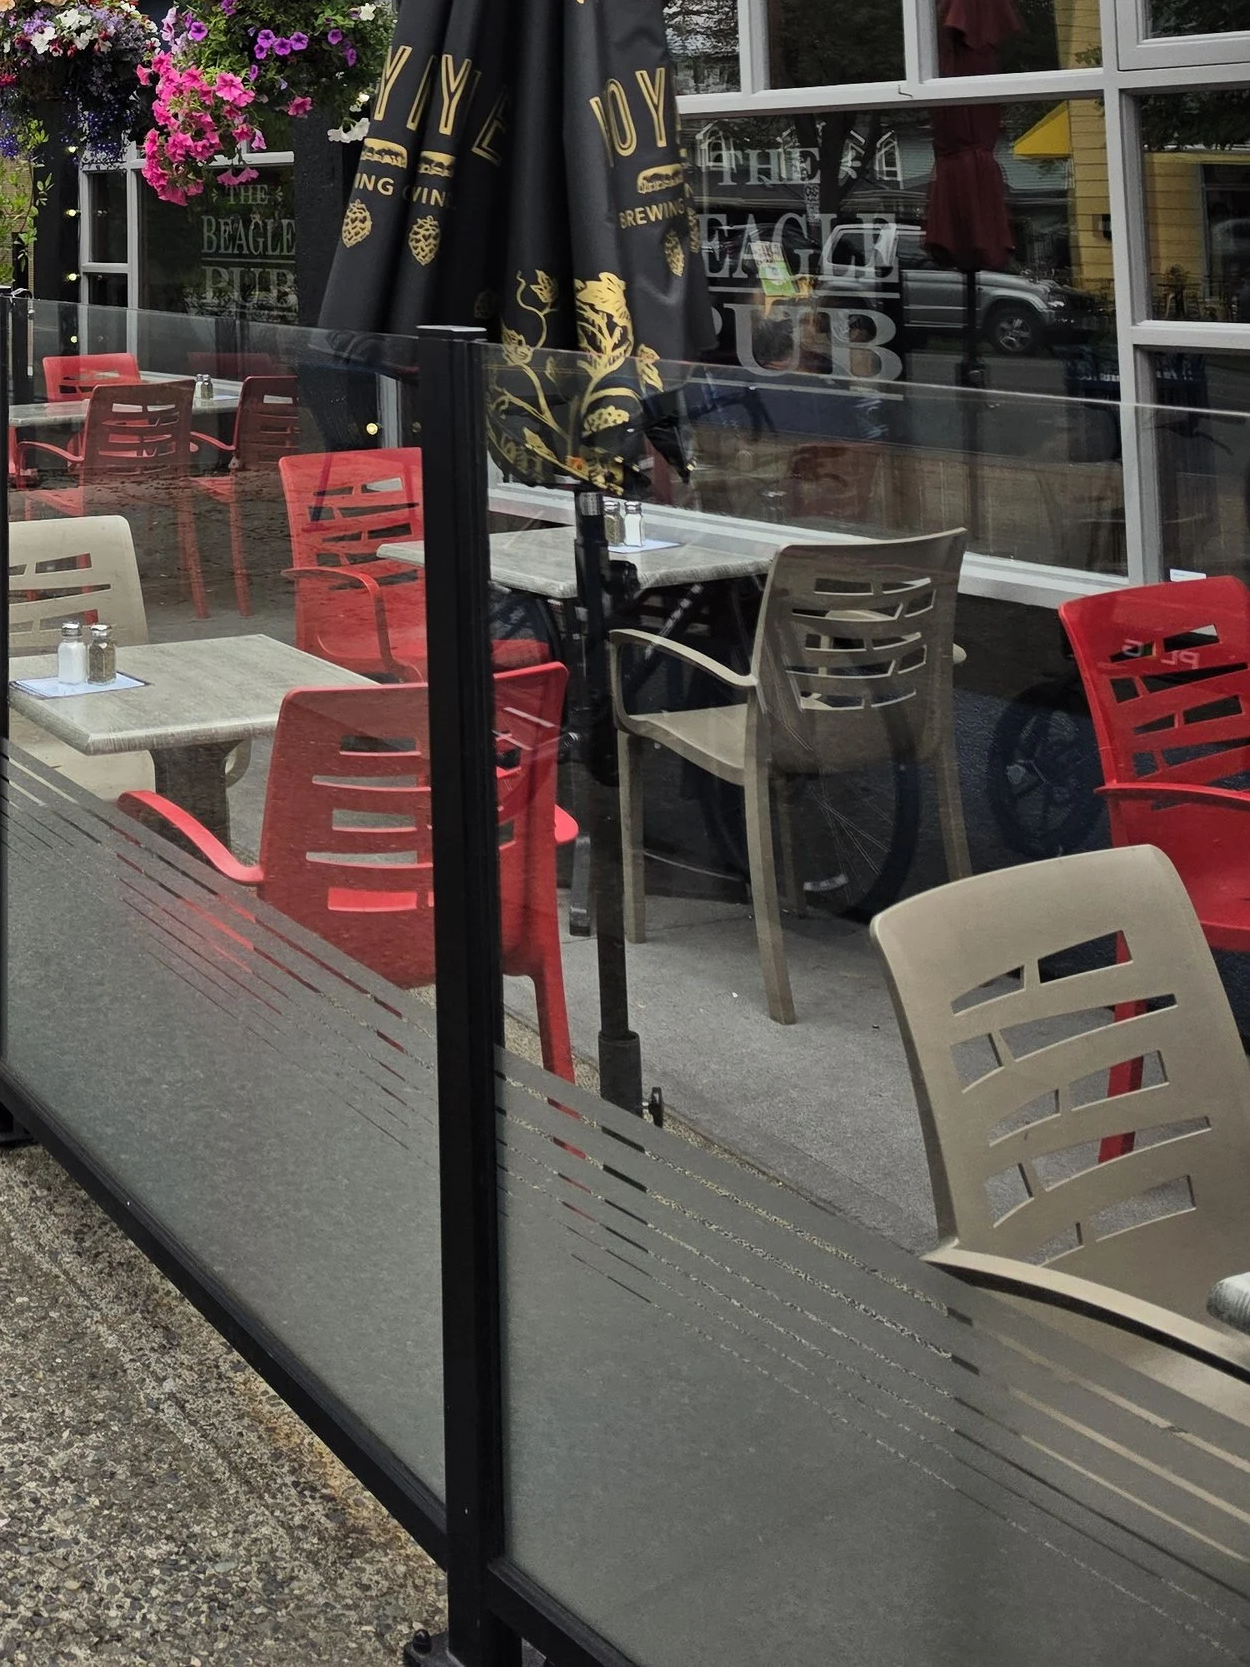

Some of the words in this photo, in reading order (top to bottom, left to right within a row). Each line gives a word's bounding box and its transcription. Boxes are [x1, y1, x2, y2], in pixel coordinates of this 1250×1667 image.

[711, 148, 821, 185] THE
[226, 184, 270, 205] THE
[619, 200, 685, 229] BREWING
[201, 215, 296, 255] BEAGLE
[699, 213, 900, 282] EAGLE
[202, 266, 299, 310] PUB
[711, 303, 903, 378] UB
